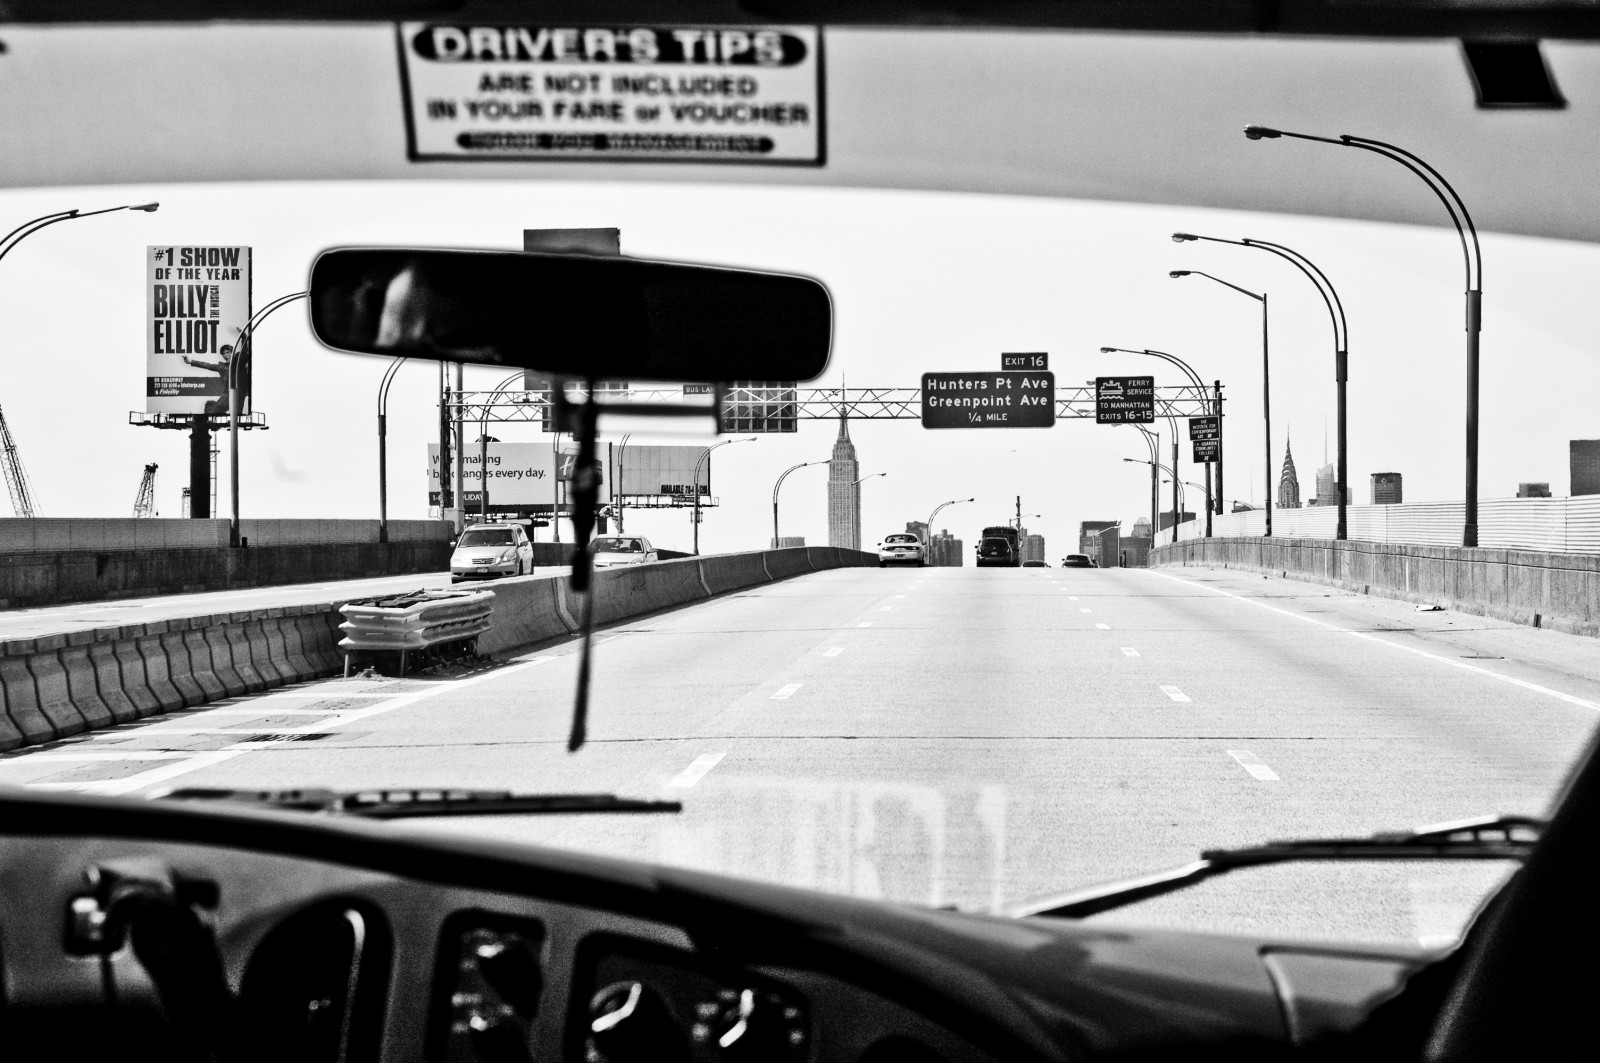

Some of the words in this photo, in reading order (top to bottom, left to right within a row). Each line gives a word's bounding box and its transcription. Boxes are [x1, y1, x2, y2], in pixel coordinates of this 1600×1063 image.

[432, 27, 660, 61] DRIVER'S
[672, 30, 784, 63] TIPS
[478, 73, 533, 93] ARE
[544, 74, 600, 93] NOT
[612, 75, 758, 96] INCLUDED
[428, 101, 457, 119] IN
[466, 102, 544, 120] YOUR
[552, 102, 625, 121] FARE
[670, 103, 809, 122] VOUCHER
[180, 247, 240, 267] SHOW
[155, 267, 171, 280] OF
[176, 268, 201, 280] THE
[154, 284, 209, 318] BILLY
[154, 319, 220, 354] ELLIOT
[1005, 357, 1026, 366] EXIT
[1030, 356, 1044, 367] 16
[927, 378, 988, 390] Hunters
[995, 377, 1012, 389] Pt
[1020, 377, 1048, 389] Ave
[1128, 379, 1150, 387] FERRY
[928, 395, 1012, 409] Greenpoint
[1020, 394, 1048, 406] Ave
[986, 413, 1008, 421] MILE
[1124, 410, 1153, 420] 16-15
[495, 470, 523, 480] every
[525, 468, 546, 480] day.
